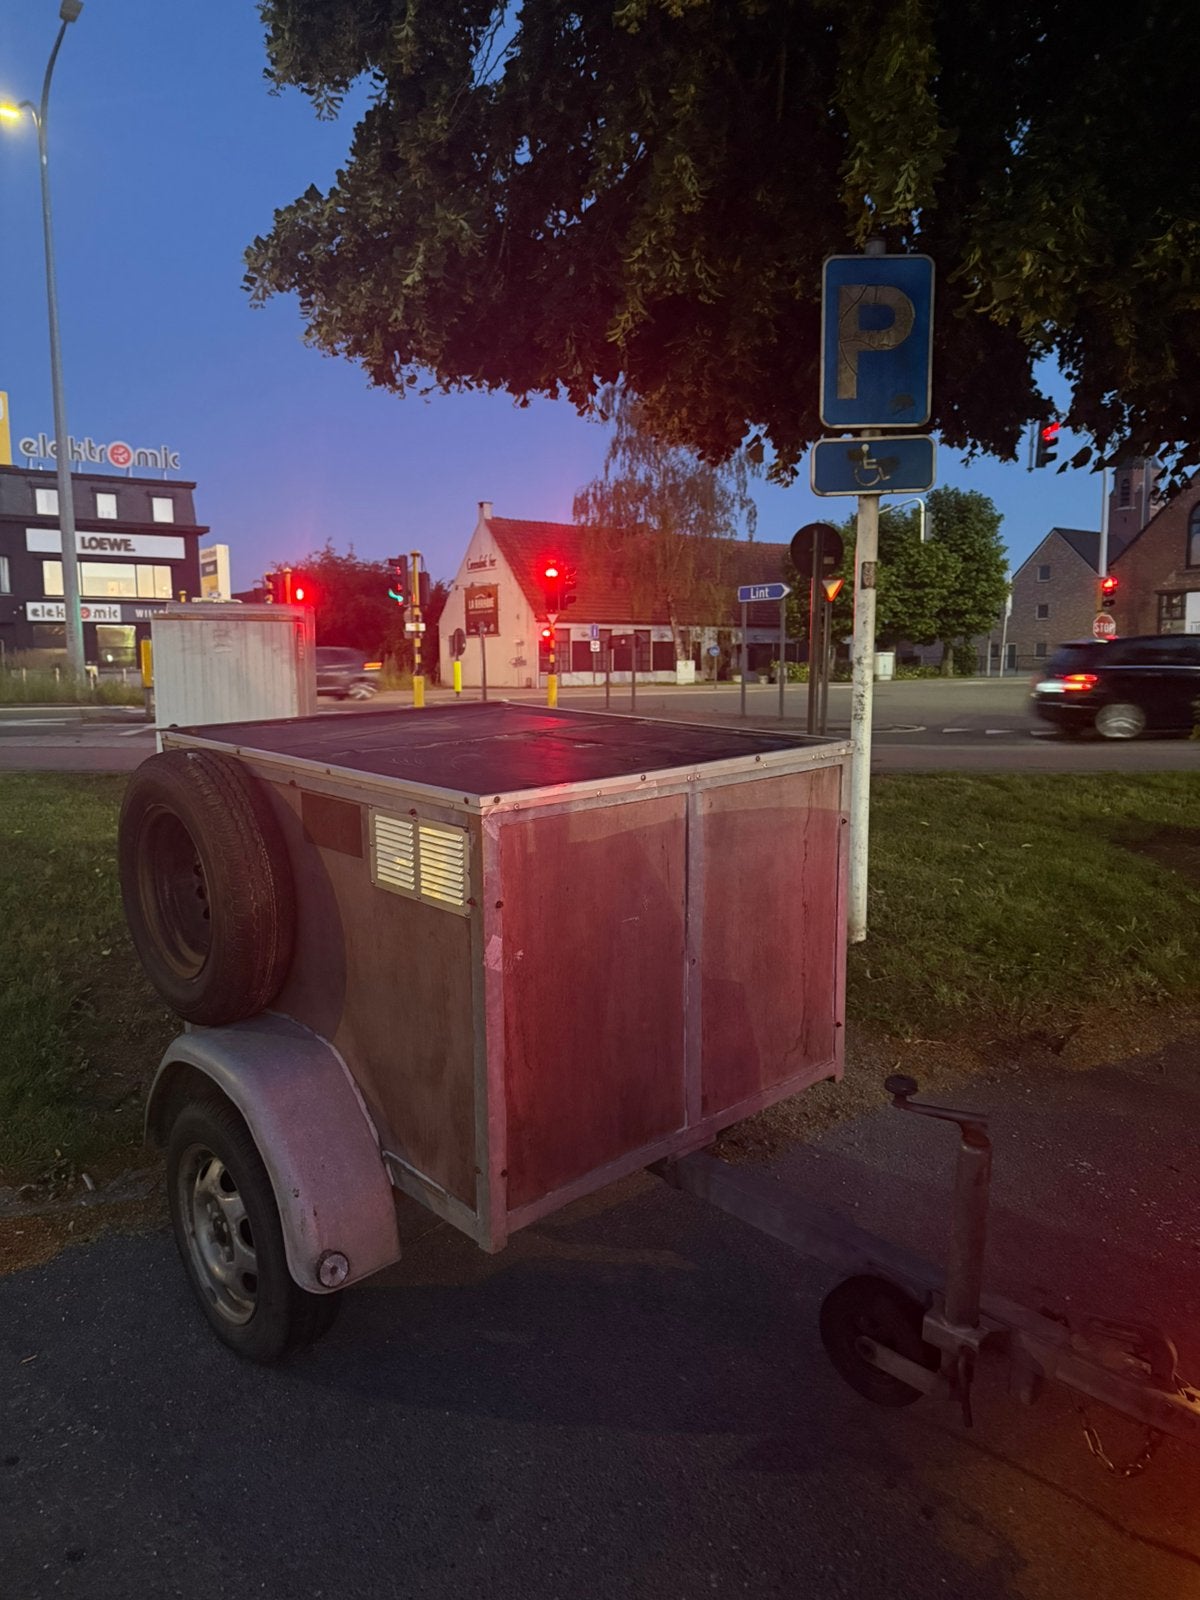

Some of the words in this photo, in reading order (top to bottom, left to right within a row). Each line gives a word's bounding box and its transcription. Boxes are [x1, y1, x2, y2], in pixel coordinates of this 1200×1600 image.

[836, 284, 916, 400] P
[750, 586, 769, 599] Lint
[1094, 622, 1115, 633] STOP
